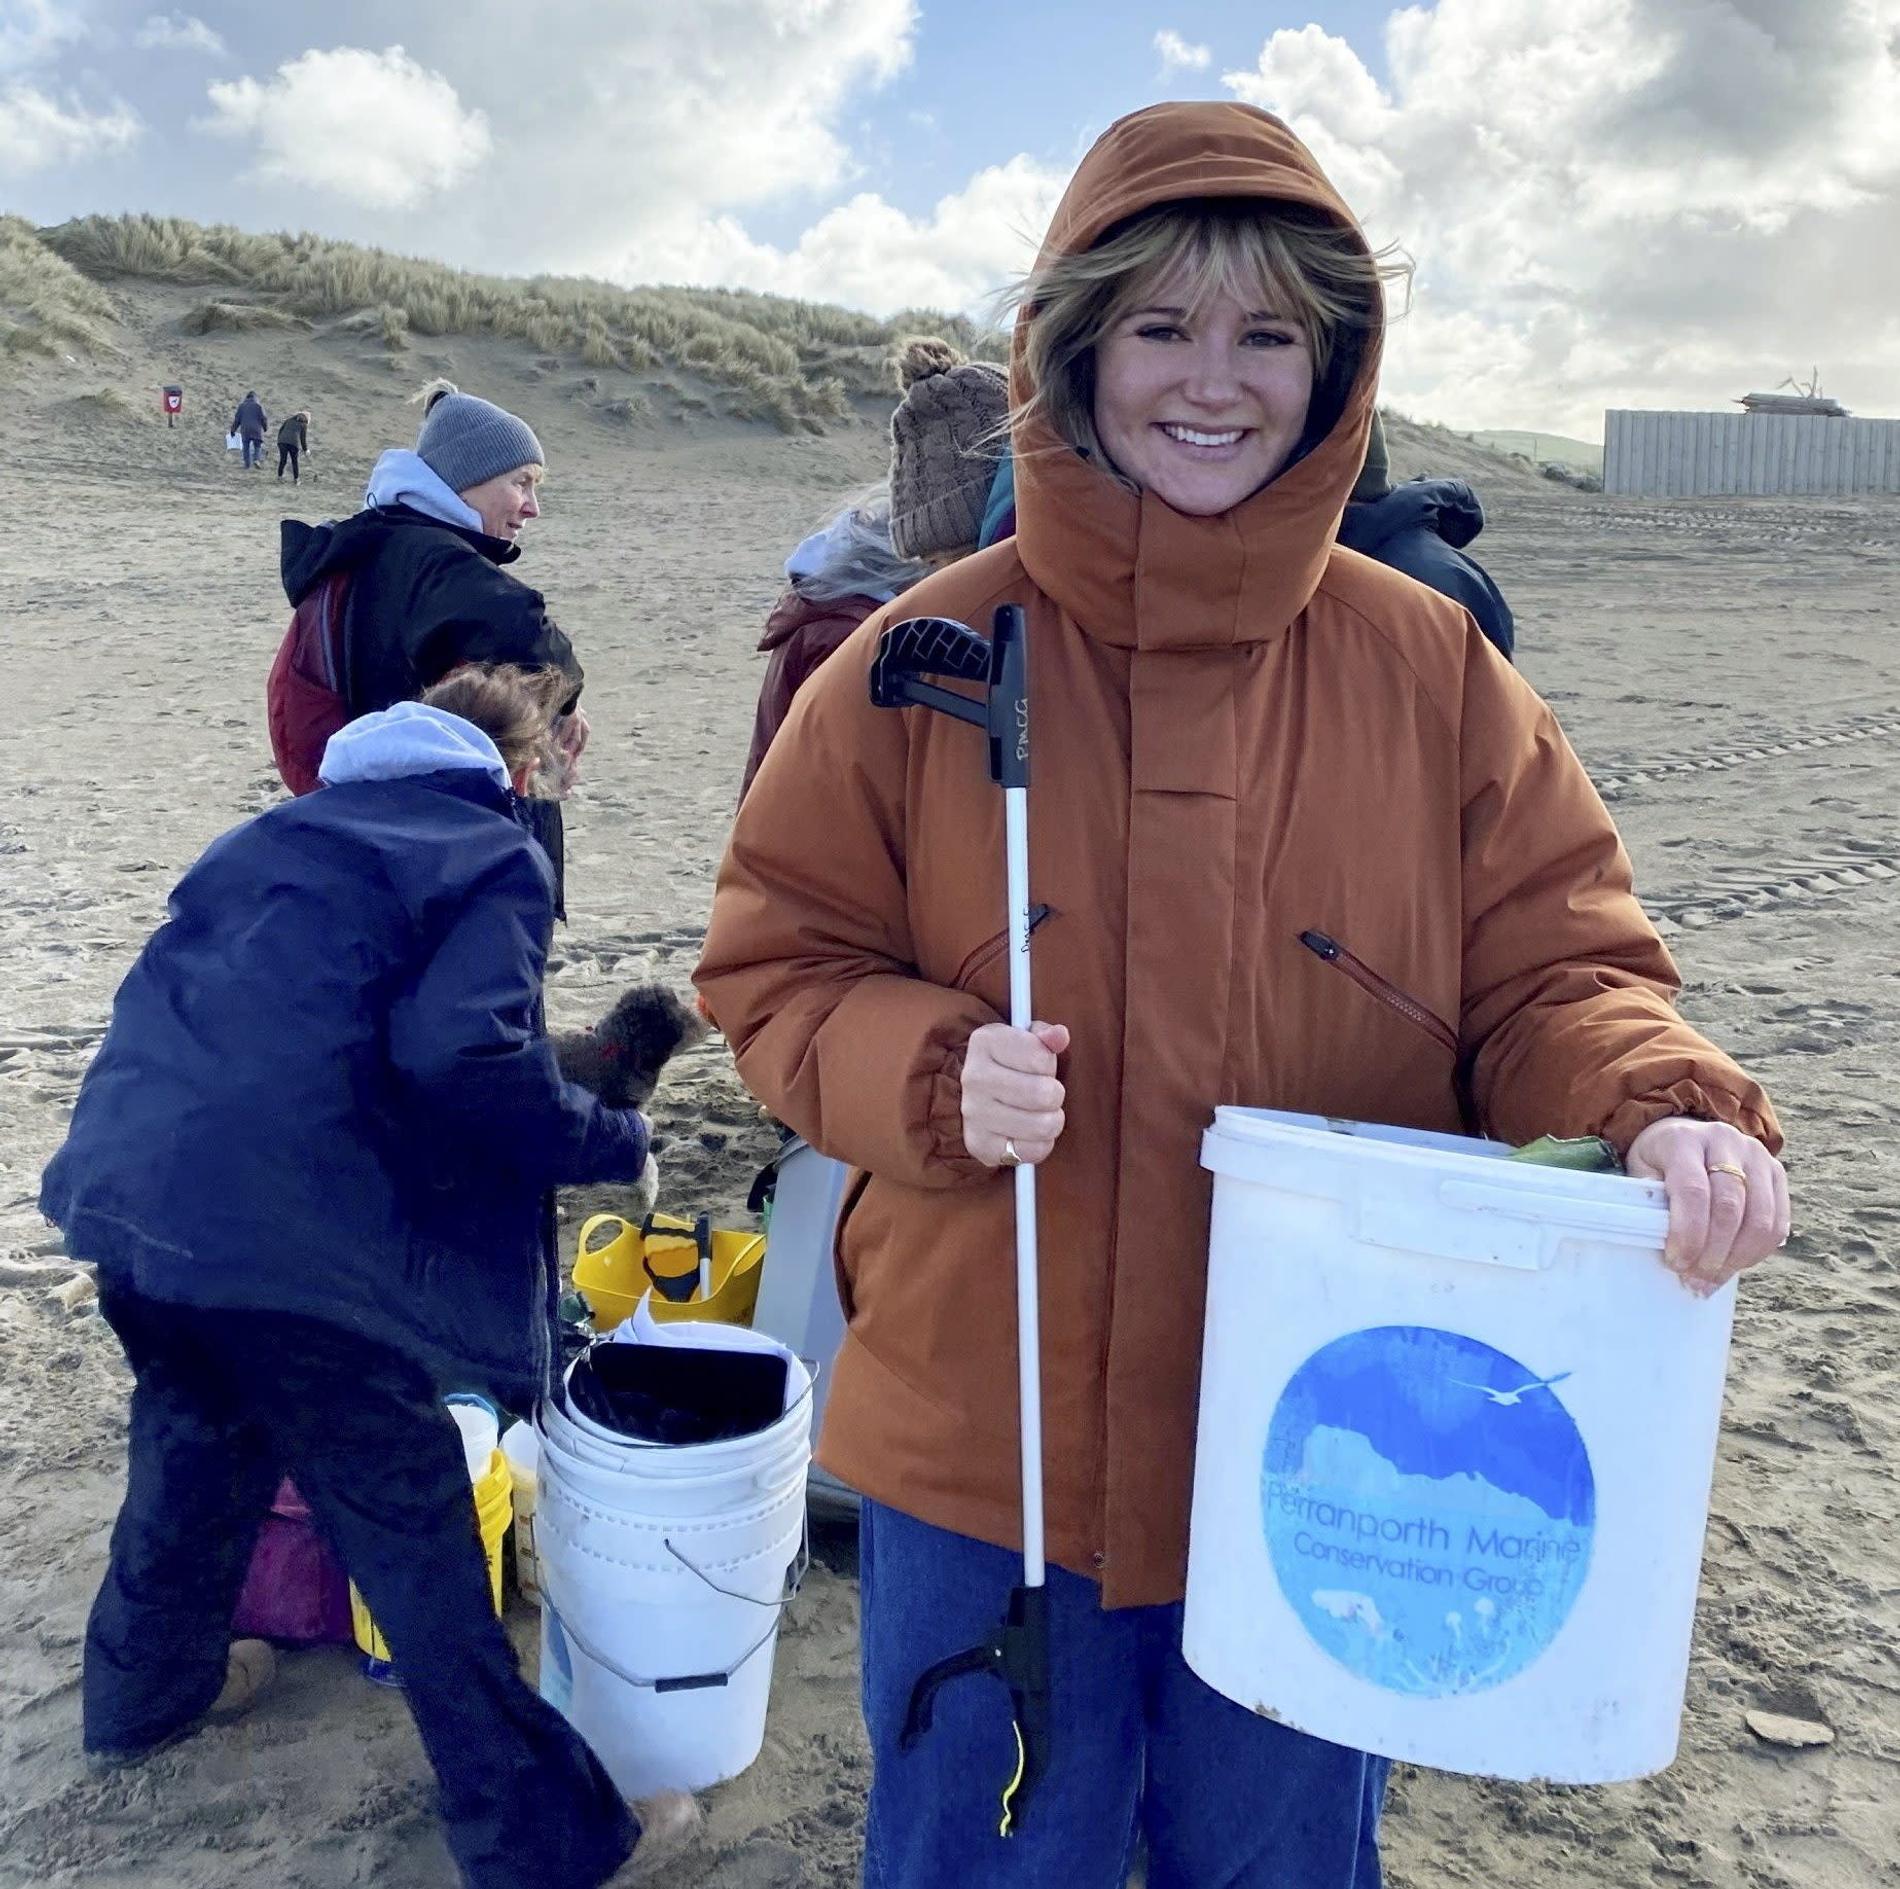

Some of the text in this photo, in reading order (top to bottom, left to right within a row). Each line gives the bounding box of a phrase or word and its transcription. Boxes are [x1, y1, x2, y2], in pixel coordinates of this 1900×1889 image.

[1267, 1480, 1582, 1563] Perranporth Marine
[1293, 1531, 1453, 1588] Conservation
